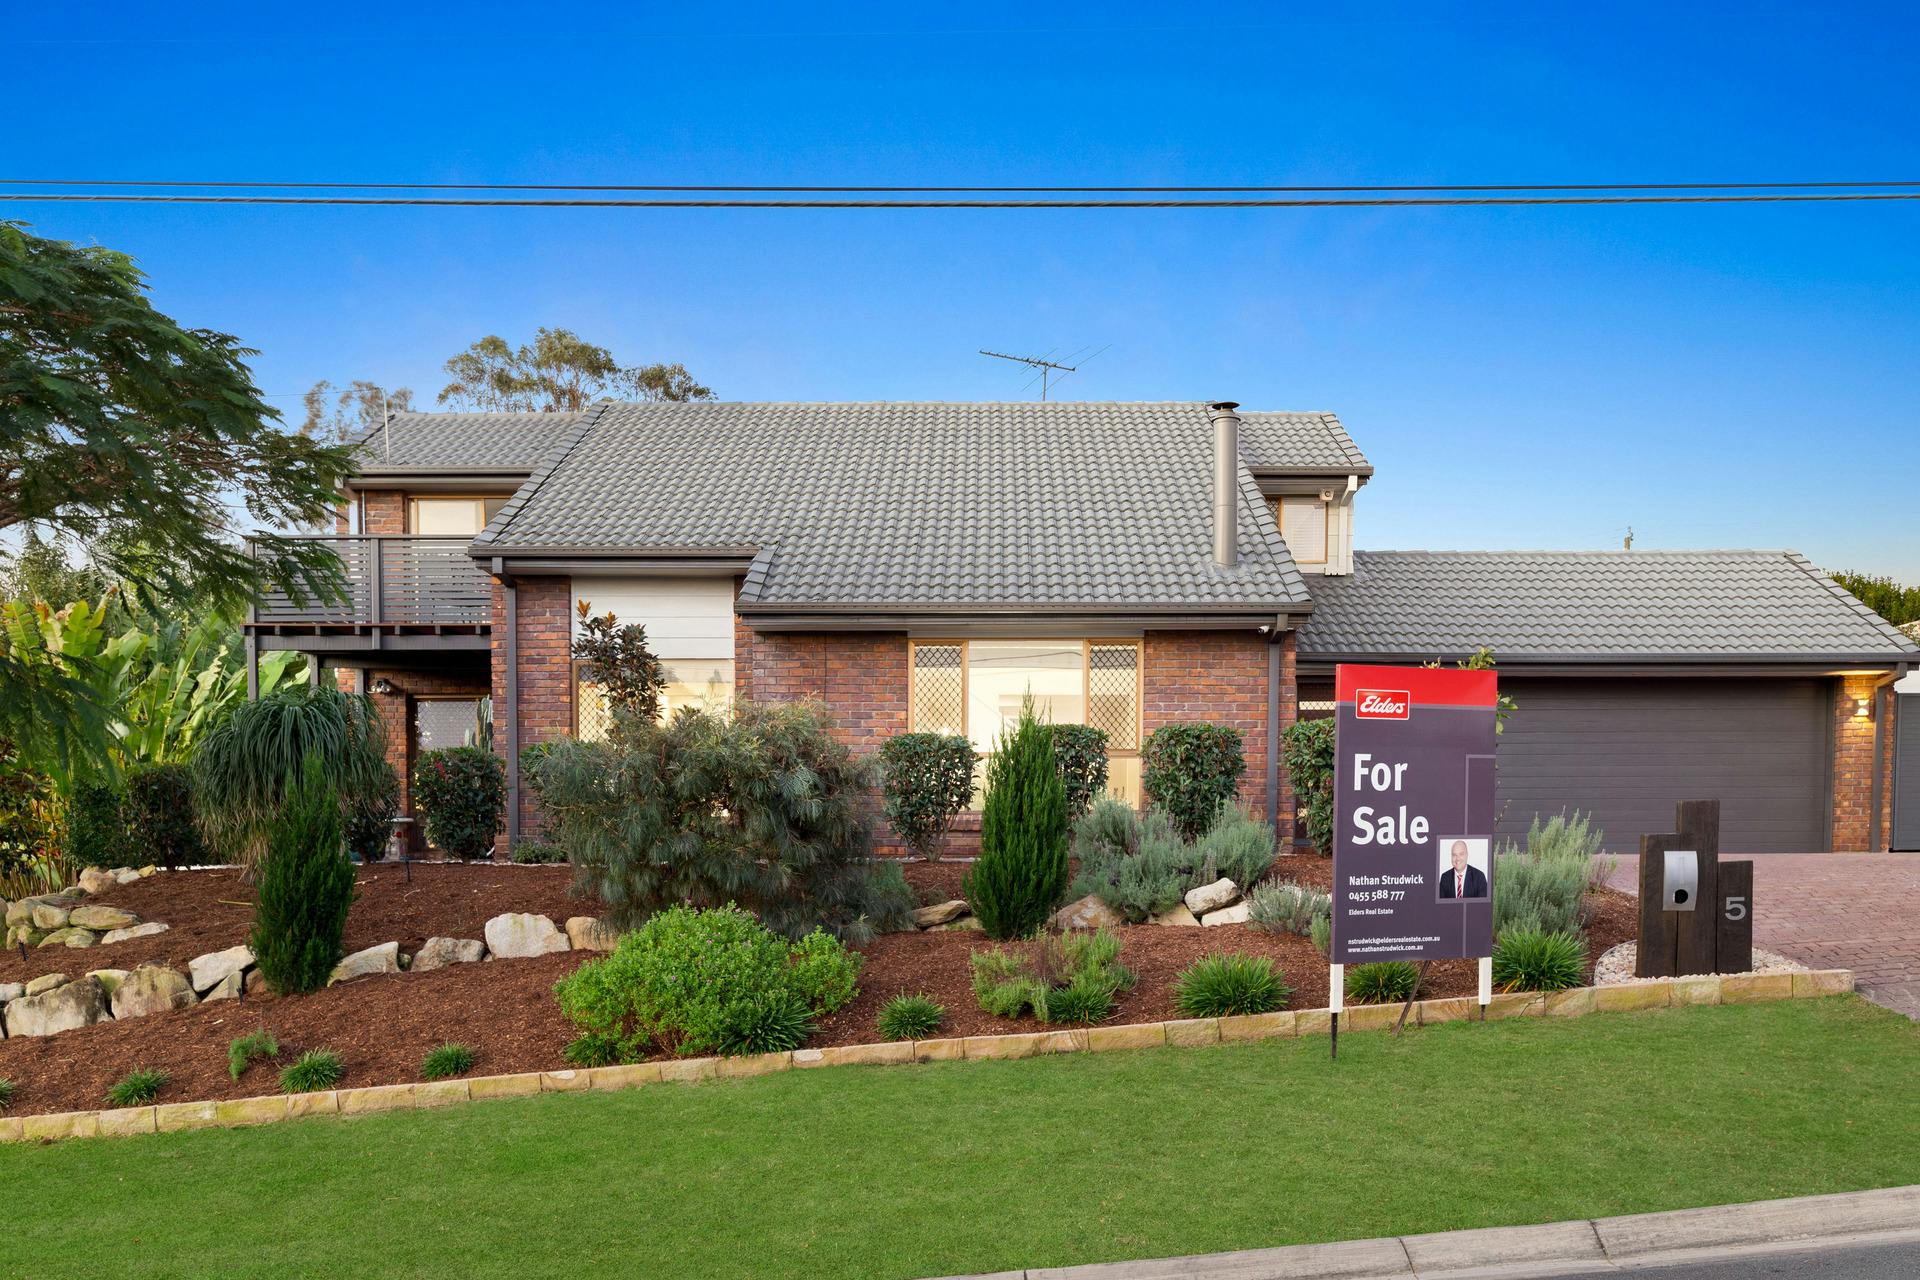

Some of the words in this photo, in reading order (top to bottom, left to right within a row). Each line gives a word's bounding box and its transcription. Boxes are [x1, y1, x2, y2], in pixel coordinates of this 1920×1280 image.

[1360, 695, 1405, 714] Elders
[1354, 753, 1408, 791] For
[1352, 805, 1429, 845] Sale
[1349, 875, 1380, 886] Nathan
[1381, 874, 1424, 885] Strudwick
[1349, 891, 1370, 902] 0455
[1371, 890, 1389, 901] 588
[1390, 891, 1405, 901] 777
[1725, 897, 1746, 921] 5
[1347, 936, 1441, 945] nstrudwick@eldersrealestate.com.au
[1347, 945, 1424, 953] www.nathanstrudwick.com.au
